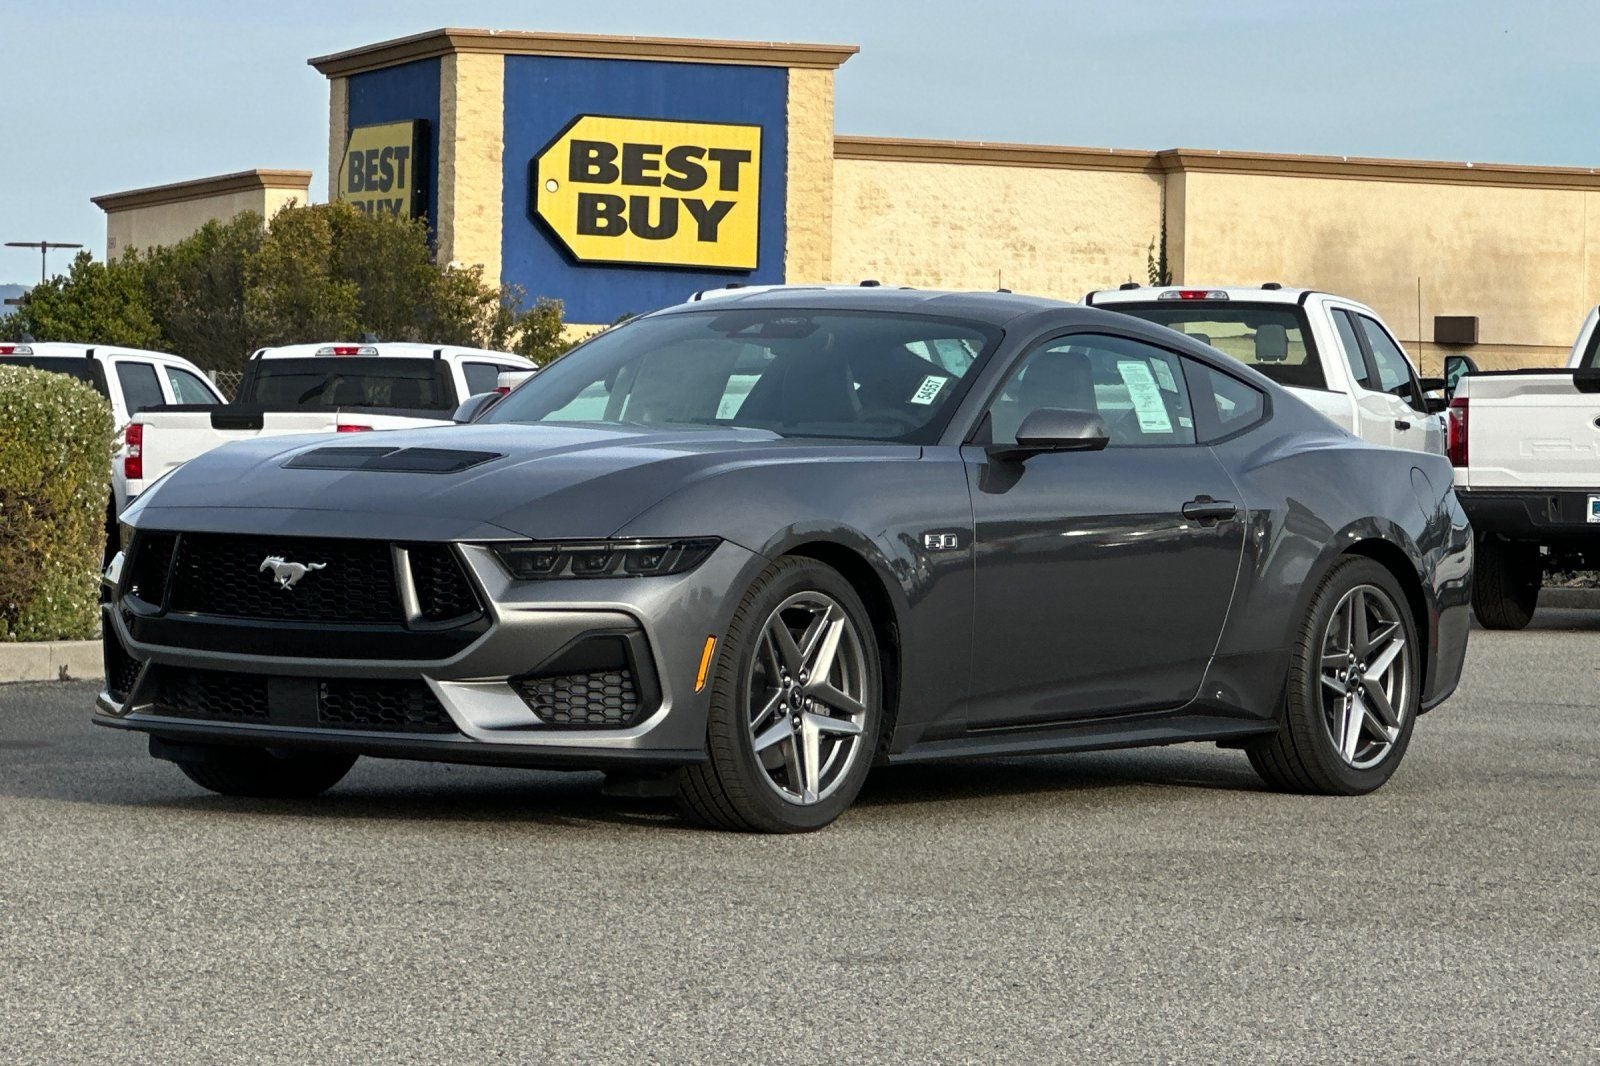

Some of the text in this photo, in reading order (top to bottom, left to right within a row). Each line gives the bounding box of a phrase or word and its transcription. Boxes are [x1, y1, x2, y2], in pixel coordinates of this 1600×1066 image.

[348, 146, 410, 193] BEST
[568, 139, 752, 192] BEST
[576, 192, 737, 243] BUY
